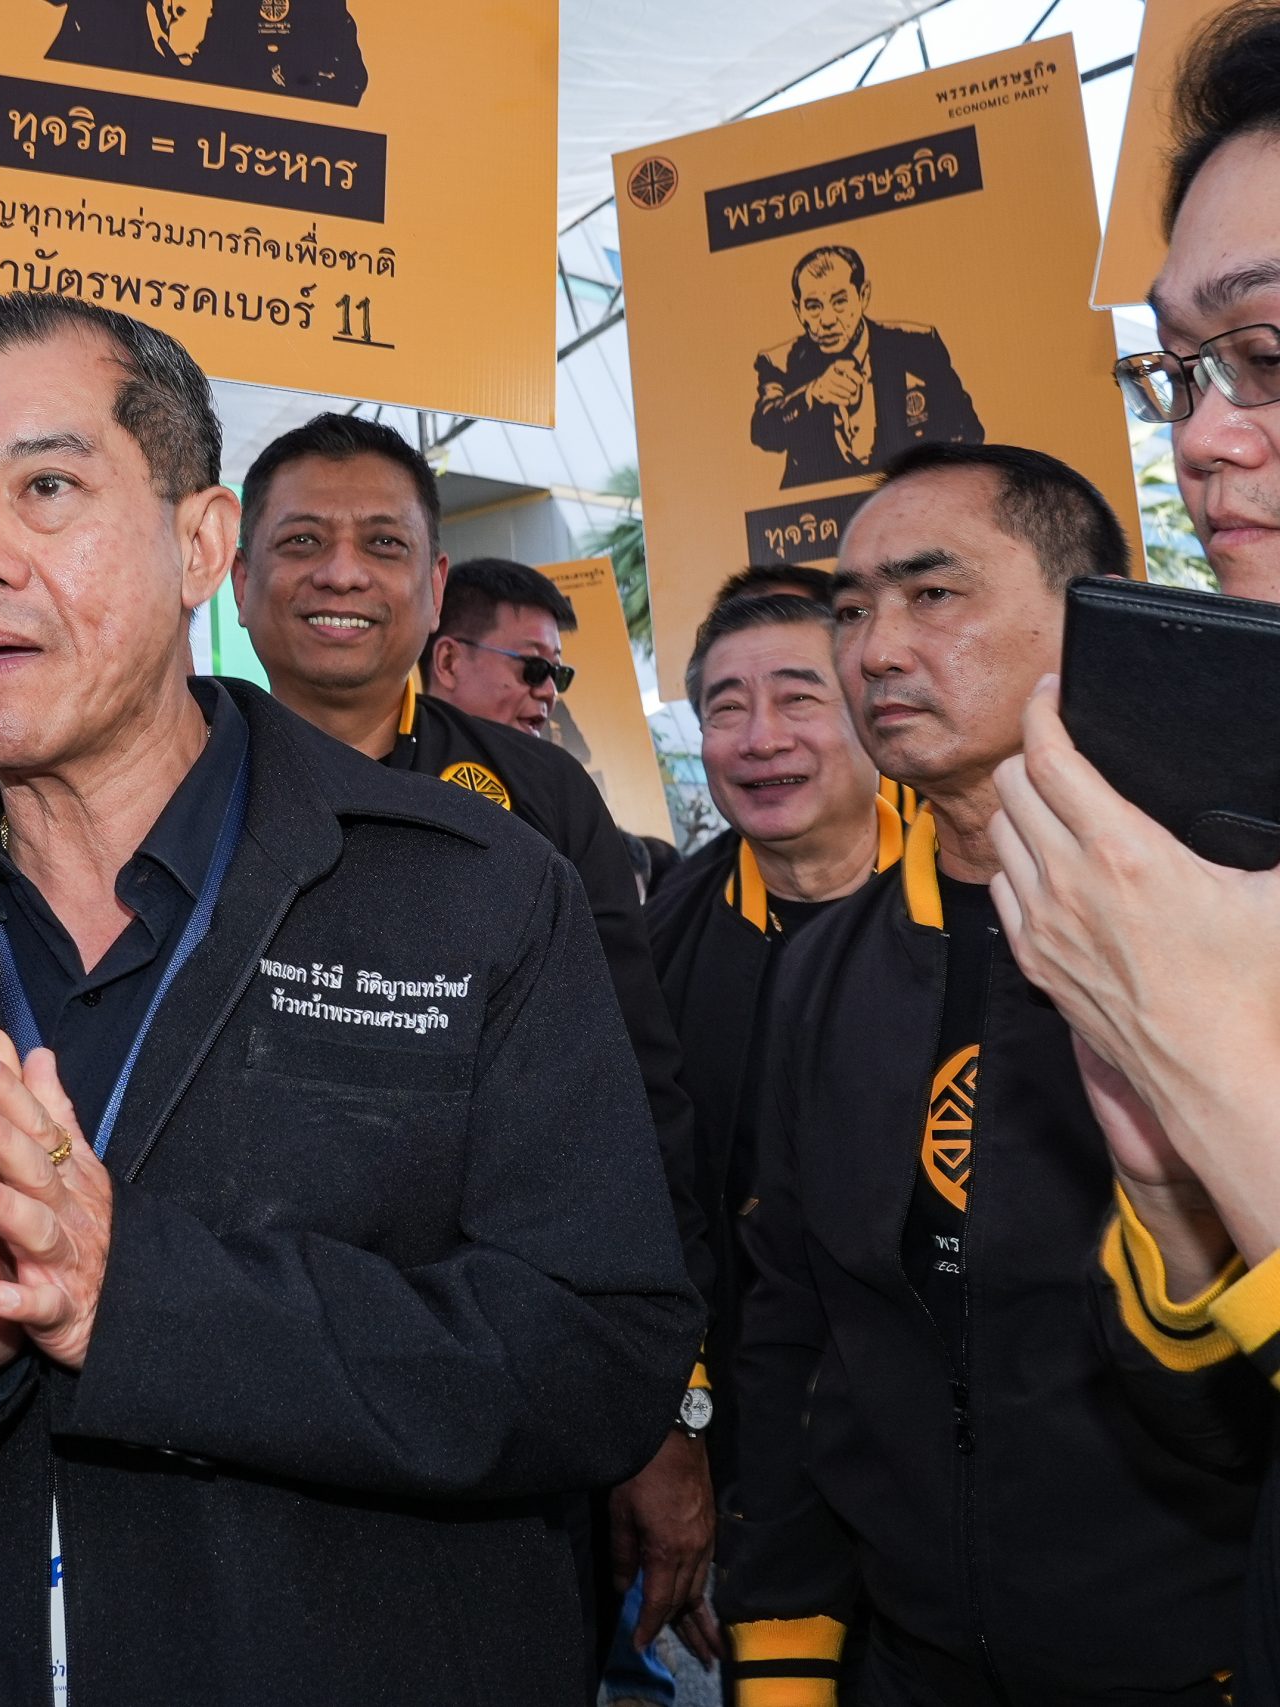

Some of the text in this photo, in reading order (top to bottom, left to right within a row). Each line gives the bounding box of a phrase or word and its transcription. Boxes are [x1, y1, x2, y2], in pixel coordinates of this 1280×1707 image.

[935, 61, 1056, 103] พรรคเศรษฐกิจ
[948, 84, 1049, 118] ECONOMIC PARTY
[7, 105, 127, 160] ทุจริต
[197, 131, 358, 191] ประหาร
[723, 147, 960, 231] พรรคเศรษฐกิจ
[333, 294, 373, 342] 11
[765, 513, 839, 559] ทุจริต
[260, 956, 307, 984] พลเอก
[311, 963, 344, 991] รังษี
[271, 987, 449, 1035] หัวหน้าพรรคเศรษฐกิจ
